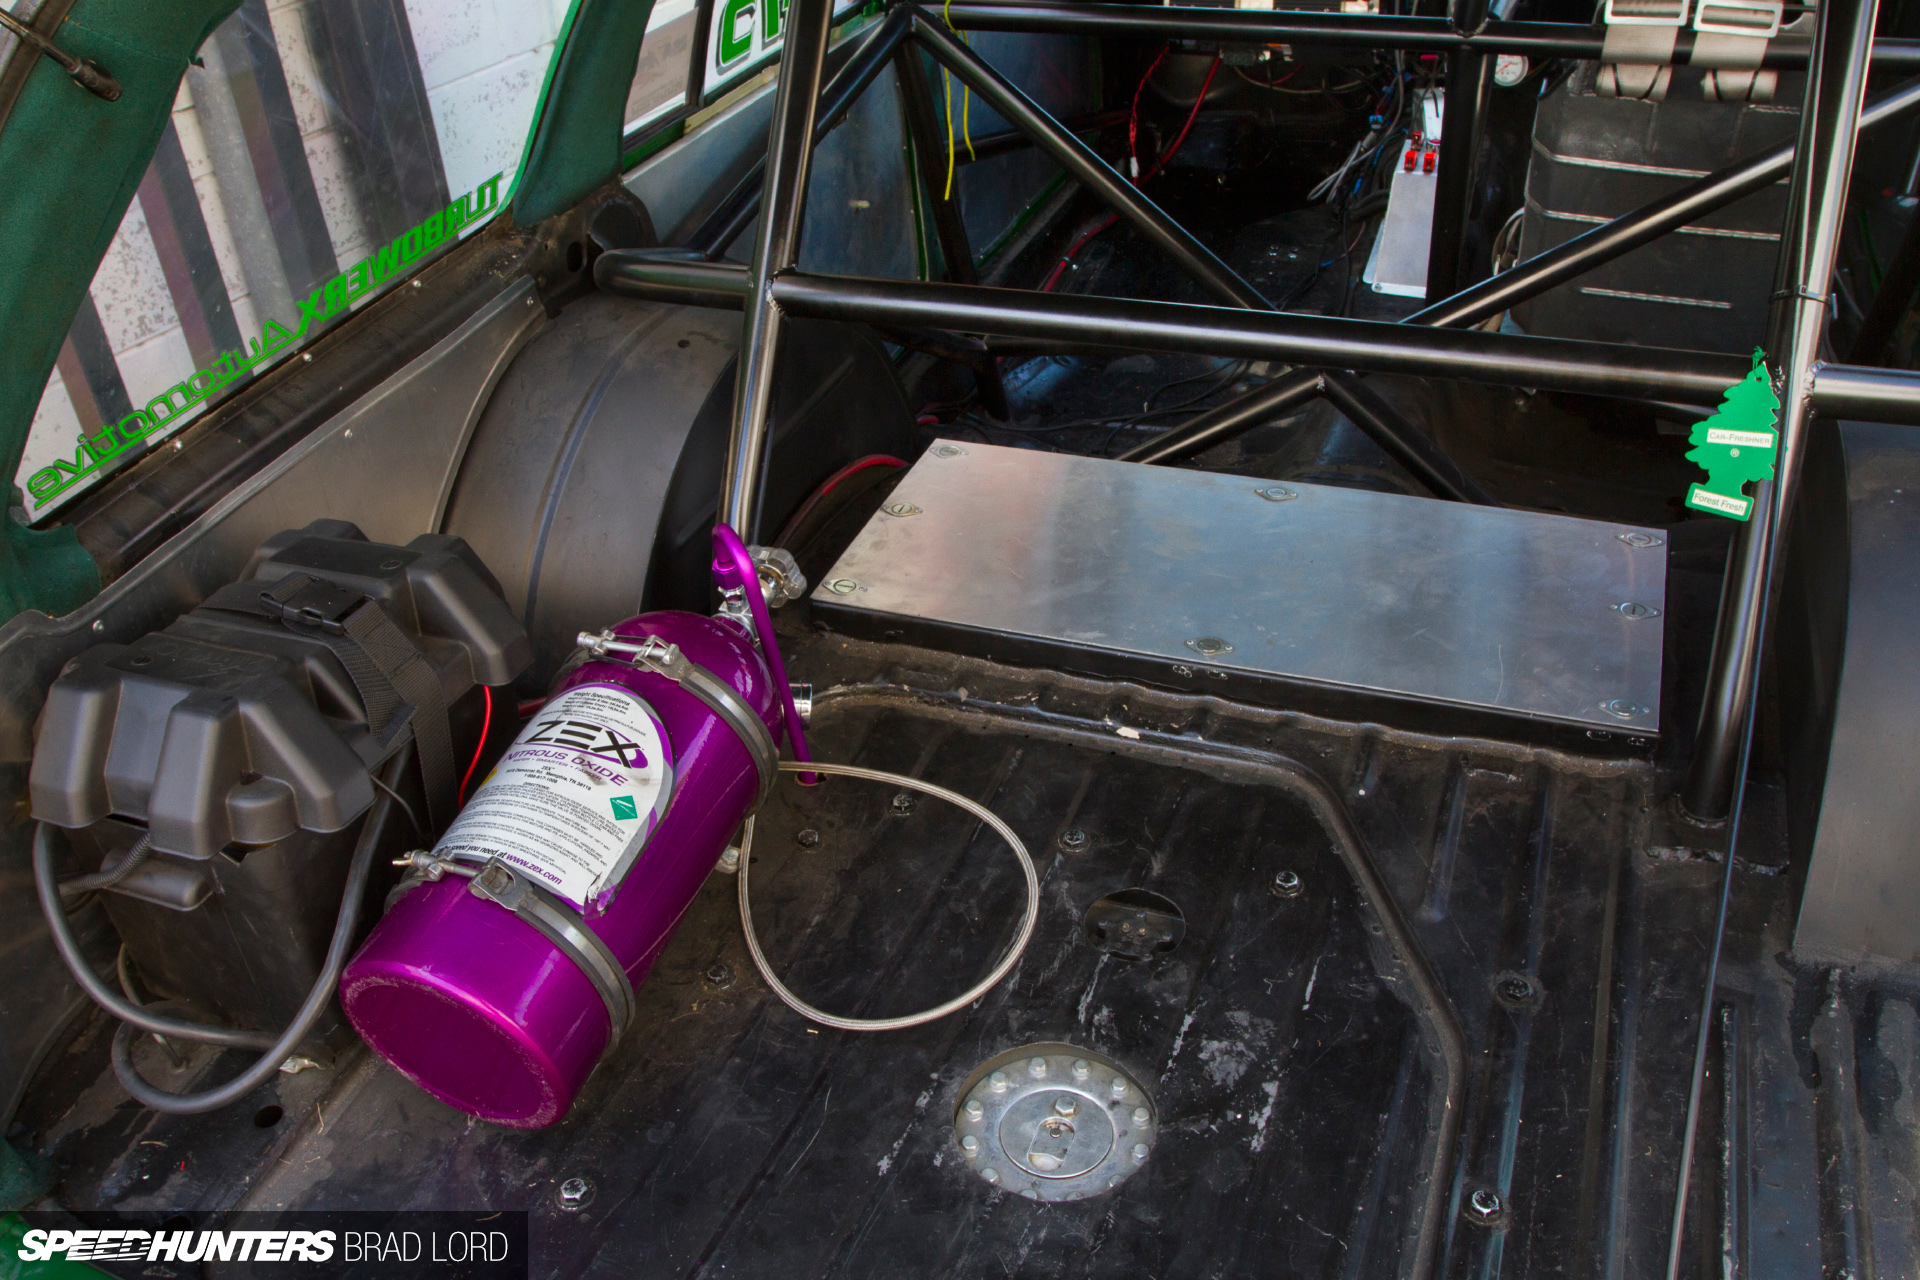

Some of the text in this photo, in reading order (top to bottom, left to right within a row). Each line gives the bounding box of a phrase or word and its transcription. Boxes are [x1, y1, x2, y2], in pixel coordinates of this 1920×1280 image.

[1694, 493, 1744, 512] Forest Fresh
[523, 720, 640, 769] ZEX
[503, 750, 629, 787] NITROUS OXIDE
[546, 771, 568, 782] Memphis,
[480, 846, 499, 856] need
[506, 854, 563, 885] www.zex.com
